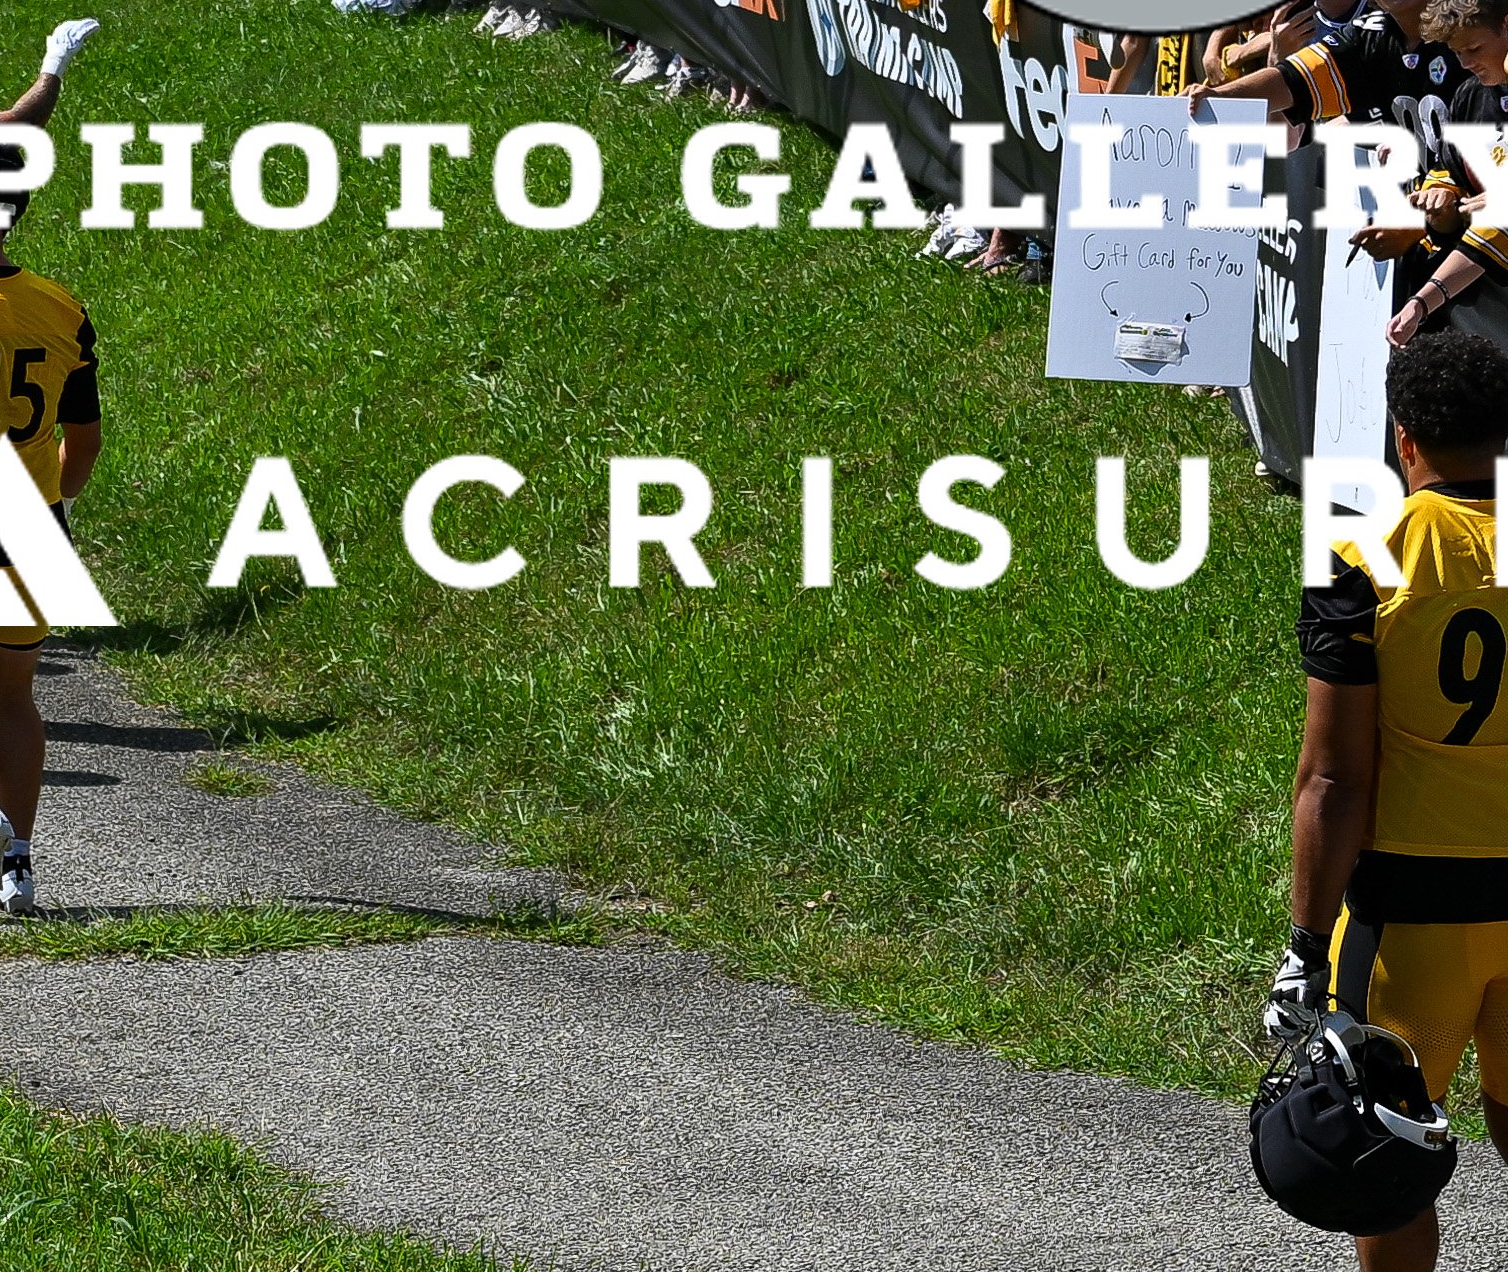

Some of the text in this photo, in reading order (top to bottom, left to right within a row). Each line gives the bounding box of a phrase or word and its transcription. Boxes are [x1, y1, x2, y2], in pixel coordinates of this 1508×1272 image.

[1082, 233, 1244, 284] Gift Card for You
